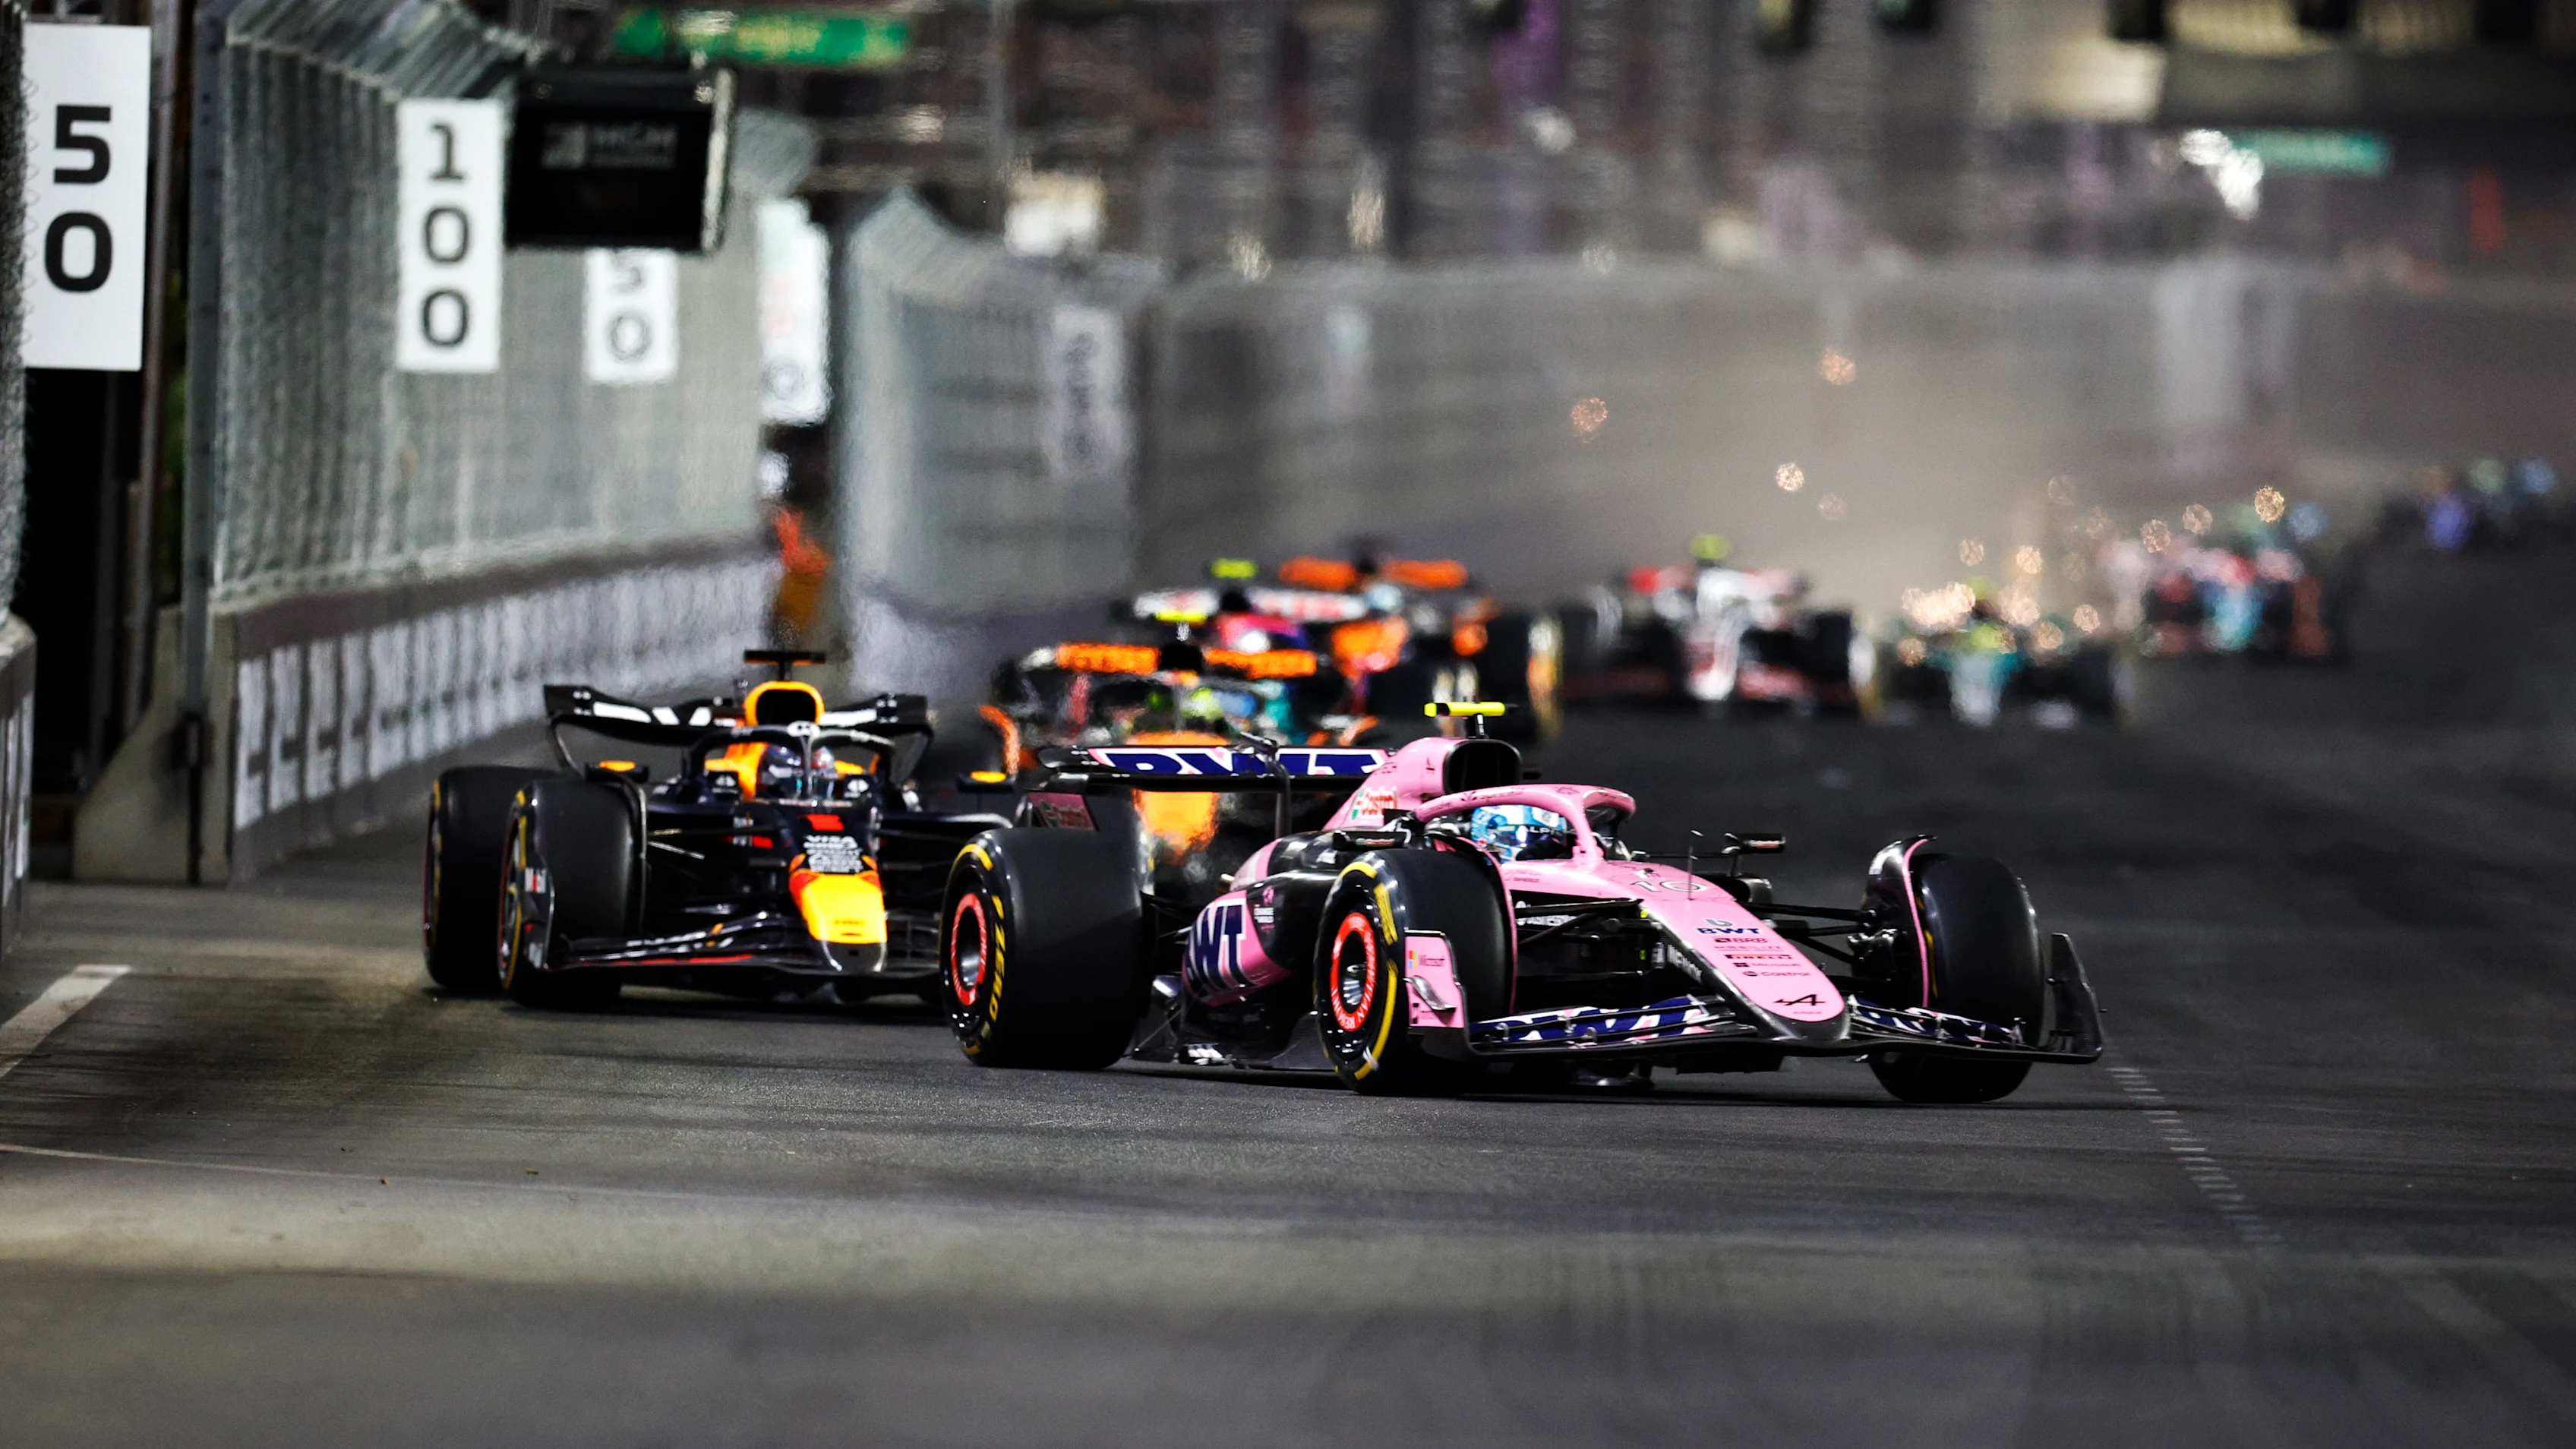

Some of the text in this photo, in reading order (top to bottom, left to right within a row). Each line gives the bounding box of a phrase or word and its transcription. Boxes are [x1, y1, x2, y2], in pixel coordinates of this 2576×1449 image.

[44, 105, 113, 293] 50
[421, 123, 471, 347] 100
[1631, 881, 1709, 892] 10
[990, 922, 1005, 1023] ZERO
